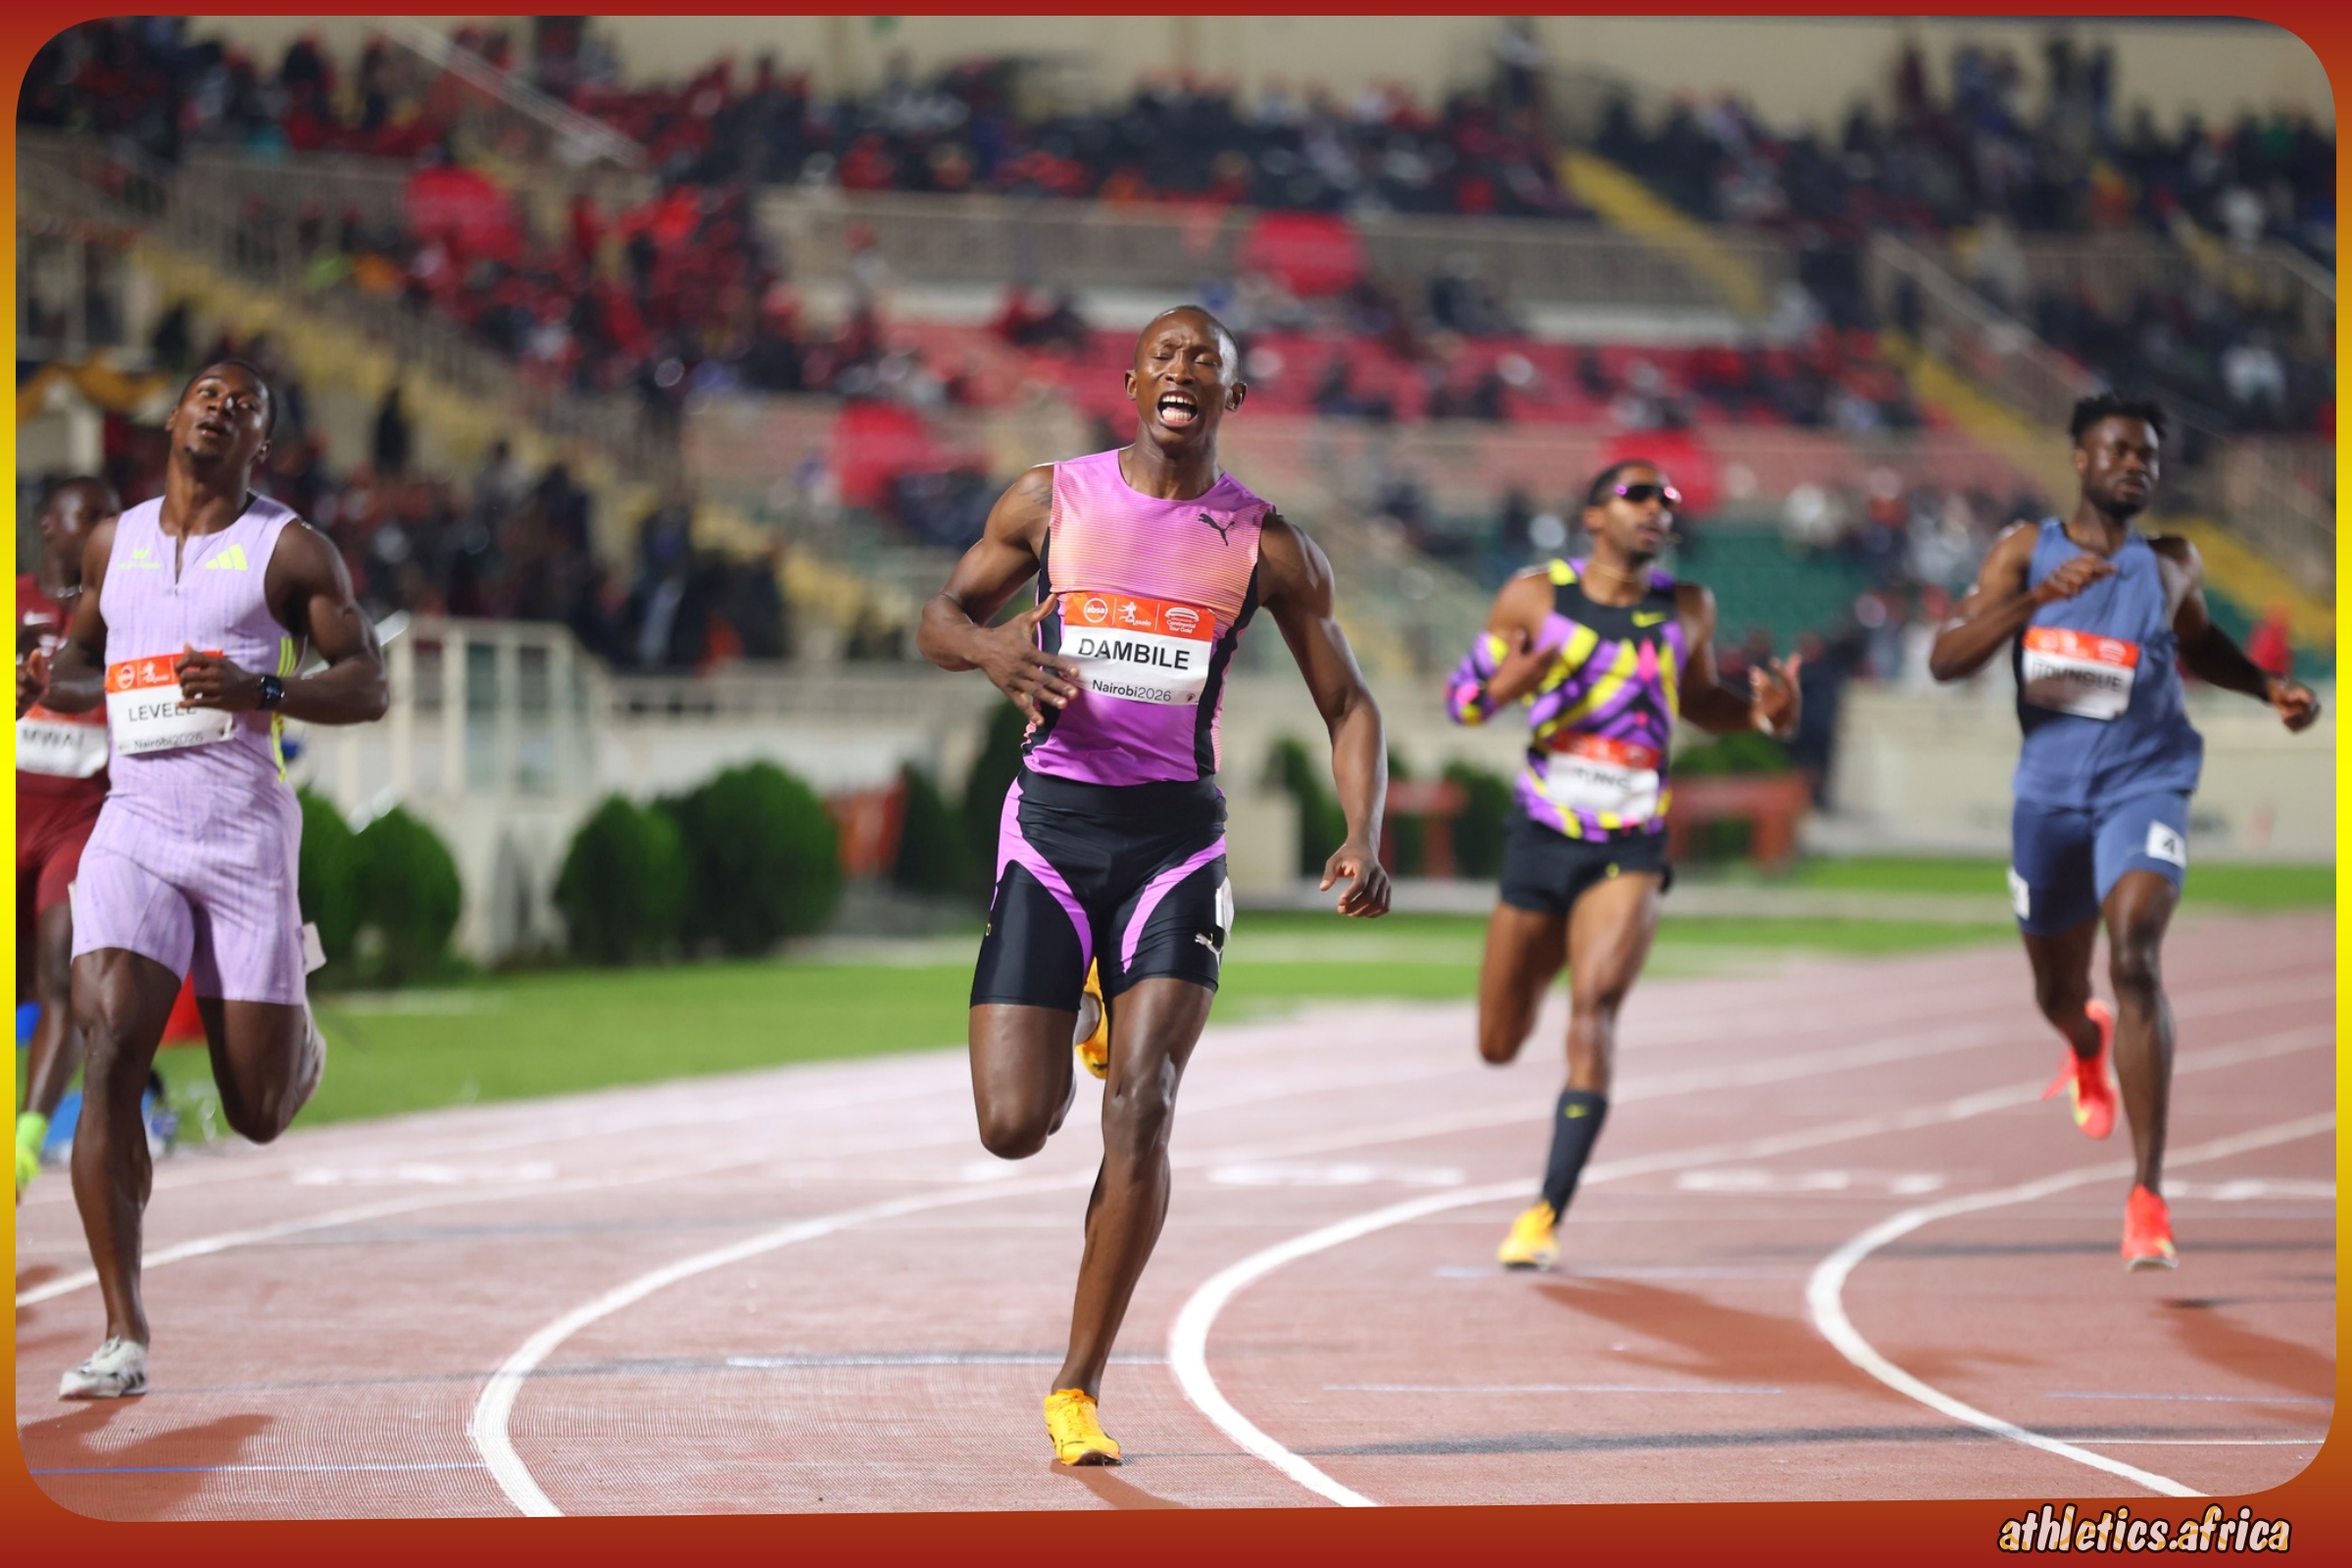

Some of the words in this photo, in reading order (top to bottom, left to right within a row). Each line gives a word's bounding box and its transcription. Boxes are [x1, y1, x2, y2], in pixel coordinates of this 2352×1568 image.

[1086, 605, 1106, 614] absa
[1077, 638, 1191, 670] DAMBILE
[1092, 679, 1172, 703] Nairobi2026
